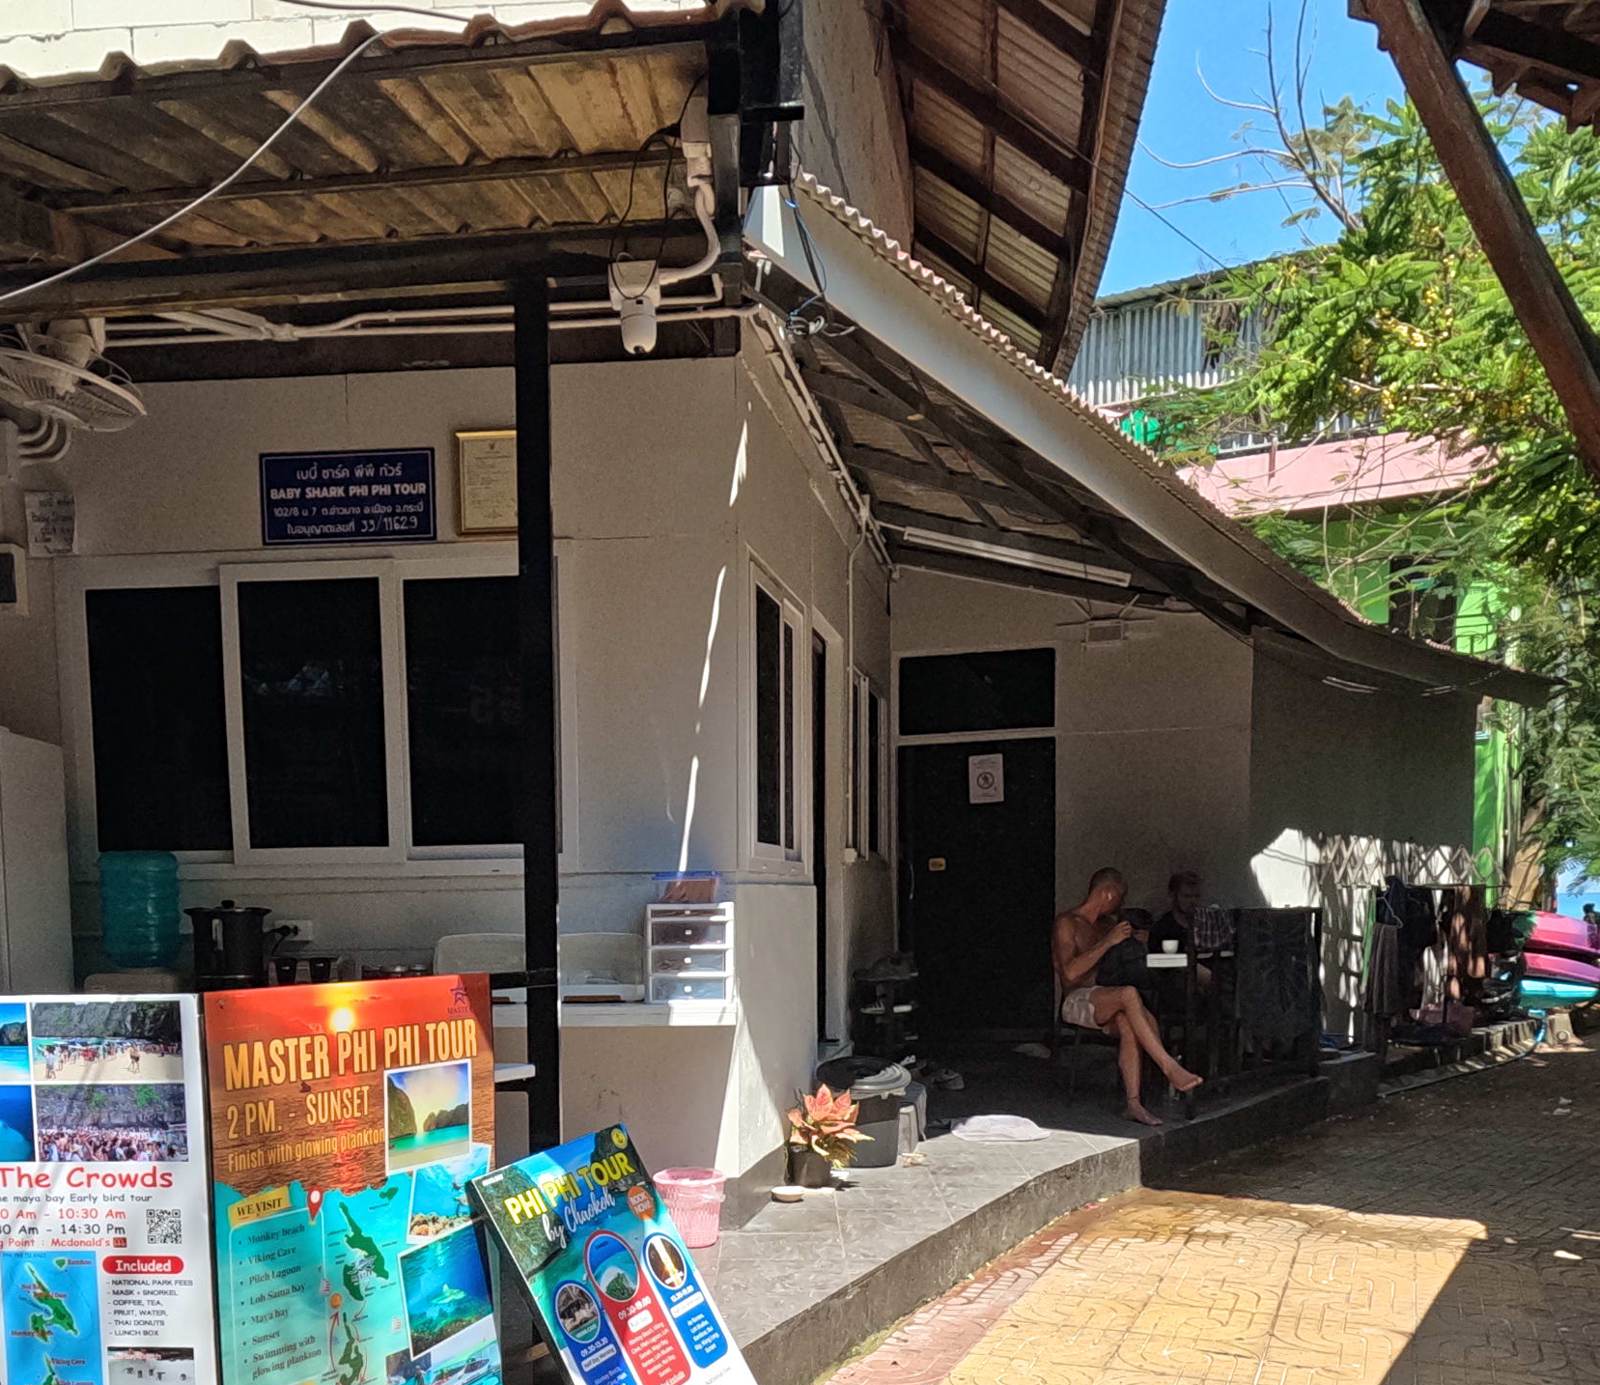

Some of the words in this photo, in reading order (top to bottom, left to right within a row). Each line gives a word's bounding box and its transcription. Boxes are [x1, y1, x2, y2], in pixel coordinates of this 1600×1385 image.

[270, 488, 301, 500] BABY
[305, 486, 346, 499] SHARK
[349, 485, 368, 497] PHI
[371, 484, 391, 496] PHI
[394, 483, 427, 495] TOUR
[223, 1035, 330, 1091] MASTER
[336, 1029, 377, 1076] PHI
[383, 1024, 421, 1068] PHI
[425, 1018, 478, 1062] TOUR
[227, 1104, 239, 1140] 2
[245, 1100, 283, 1136] PM.
[306, 1085, 371, 1126] SUNSET
[228, 1150, 265, 1173] Finish
[268, 1143, 294, 1167] with
[295, 1135, 337, 1164] glowing
[340, 1127, 385, 1154] plankton
[0, 1166, 51, 1189] The
[66, 1165, 174, 1189] Crowds
[504, 1188, 548, 1225] PHI
[542, 1172, 582, 1208] PHI
[578, 1151, 636, 1190] TOUR
[13, 1194, 41, 1204] maya
[45, 1193, 65, 1204] bay
[70, 1193, 98, 1204] Early
[102, 1192, 125, 1203] bird
[130, 1193, 153, 1203] tour
[237, 1206, 252, 1217] WE
[255, 1197, 283, 1214] VISIT
[16, 1208, 37, 1220] Am
[58, 1208, 99, 1220] 10:30
[105, 1208, 127, 1220] Am
[542, 1213, 567, 1249] by
[564, 1186, 616, 1232] Chaokoh
[18, 1224, 39, 1235] Am
[60, 1223, 101, 1236] 14:30
[107, 1223, 126, 1235] Pm
[248, 1230, 280, 1246] Monkey
[281, 1224, 305, 1237] beach
[8, 1237, 35, 1248] Point
[115, 1259, 172, 1273] Included
[248, 1253, 276, 1266] Viking
[277, 1247, 296, 1259] Cave
[111, 1279, 150, 1287] NATIONAL
[174, 1279, 193, 1287] FEES
[271, 1265, 301, 1282] Lagoon
[250, 1293, 266, 1305] Loh
[291, 1282, 306, 1296] bay
[133, 1319, 165, 1327] DONUTS
[251, 1311, 274, 1325] Maya
[274, 1306, 289, 1319] bay
[251, 1330, 281, 1344] Sunset
[252, 1342, 298, 1364] Swimming
[299, 1335, 316, 1350] with
[252, 1360, 286, 1380] glowing
